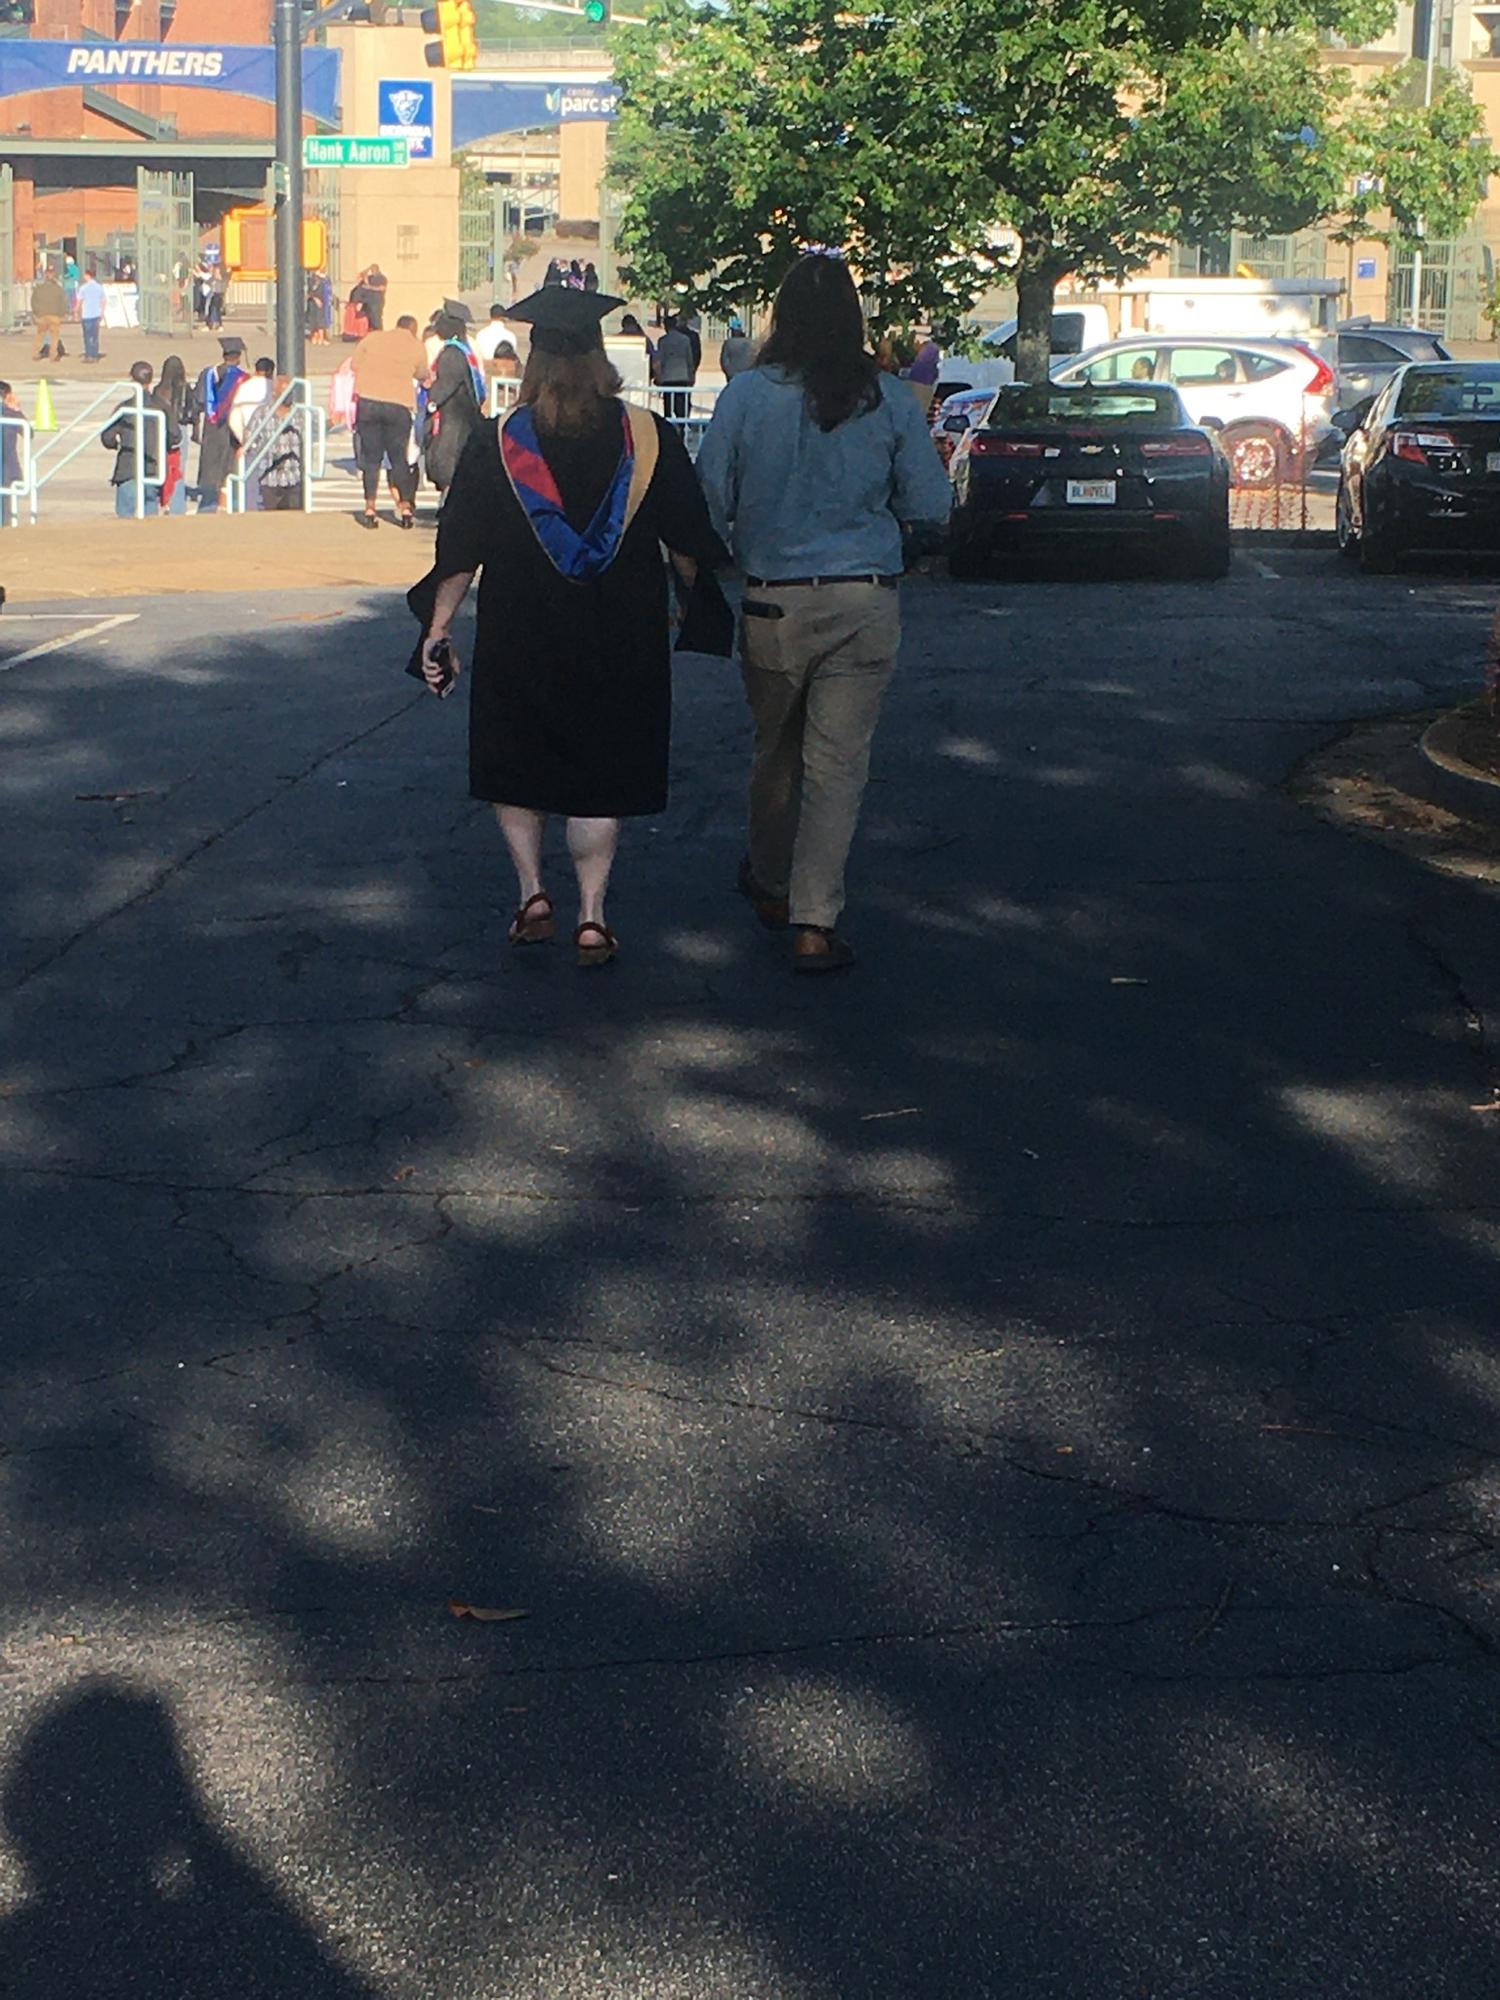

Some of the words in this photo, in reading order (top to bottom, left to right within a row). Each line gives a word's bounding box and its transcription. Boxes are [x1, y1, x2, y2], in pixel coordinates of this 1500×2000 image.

[67, 48, 223, 76] PANTHERS
[561, 97, 599, 116] parc
[309, 140, 344, 161] Hank
[349, 140, 390, 162] Aaron
